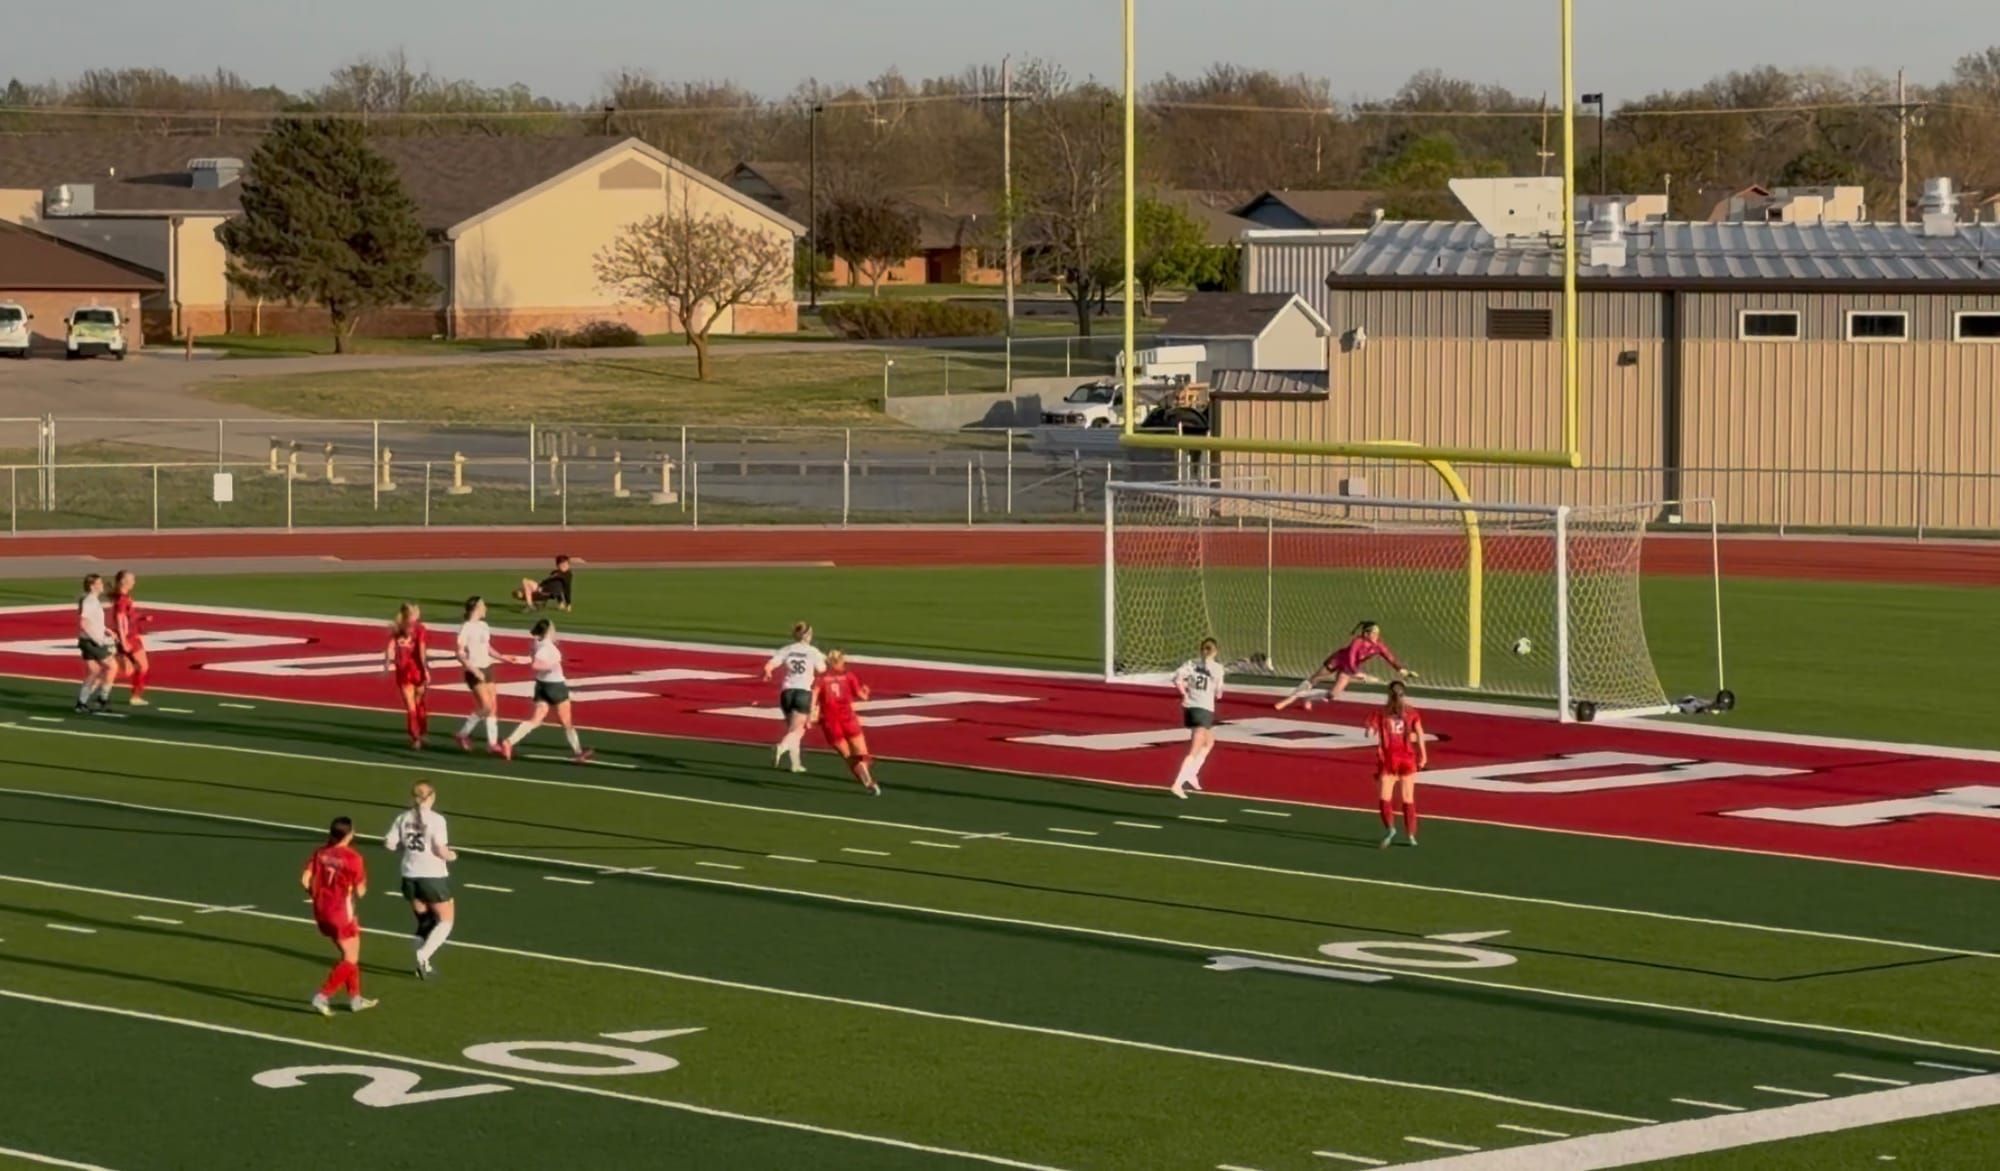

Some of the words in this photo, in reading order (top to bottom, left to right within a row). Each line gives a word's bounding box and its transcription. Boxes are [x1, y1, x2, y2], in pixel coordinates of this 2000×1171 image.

[789, 659, 806, 674] 36
[830, 682, 841, 697] 9
[1195, 675, 1208, 691] 21
[1390, 719, 1405, 735] 12
[405, 831, 426, 853] 35
[325, 866, 337, 886] 7
[1204, 939, 1518, 983] 10
[251, 1039, 680, 1108] 20
